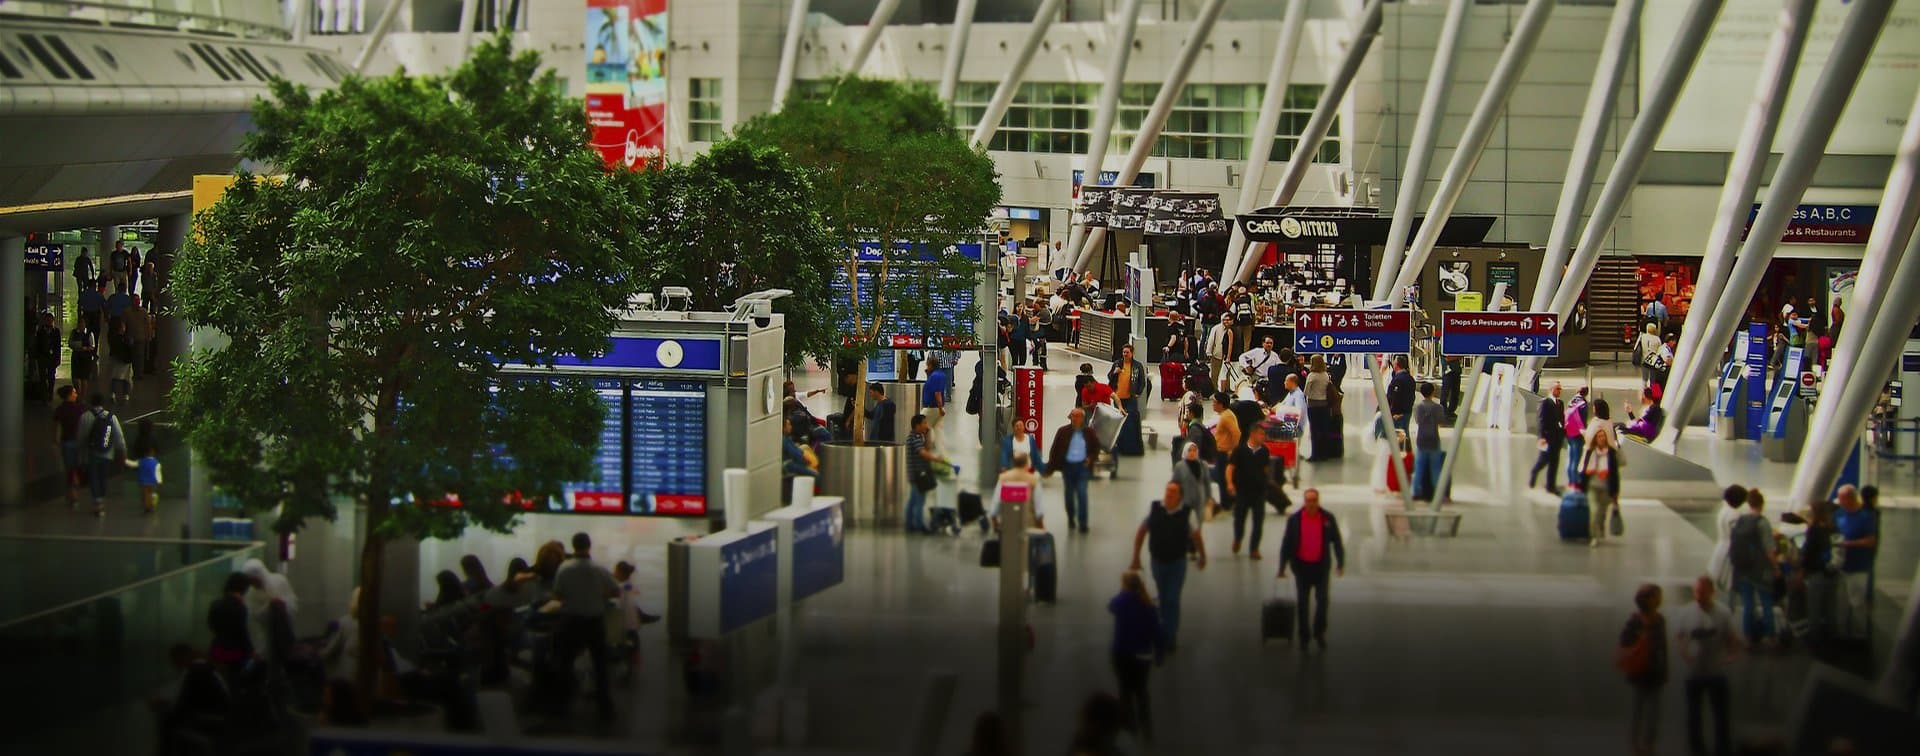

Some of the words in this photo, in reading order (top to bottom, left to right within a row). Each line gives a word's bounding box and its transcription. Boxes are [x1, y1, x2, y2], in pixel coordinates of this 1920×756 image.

[1246, 219, 1280, 234] Caffè
[1804, 227, 1857, 237] Restaurants
[1450, 318, 1471, 326] Shops
[1336, 337, 1380, 345] Information
[1488, 344, 1517, 352] Customs
[1028, 370, 1036, 417] SAFER
